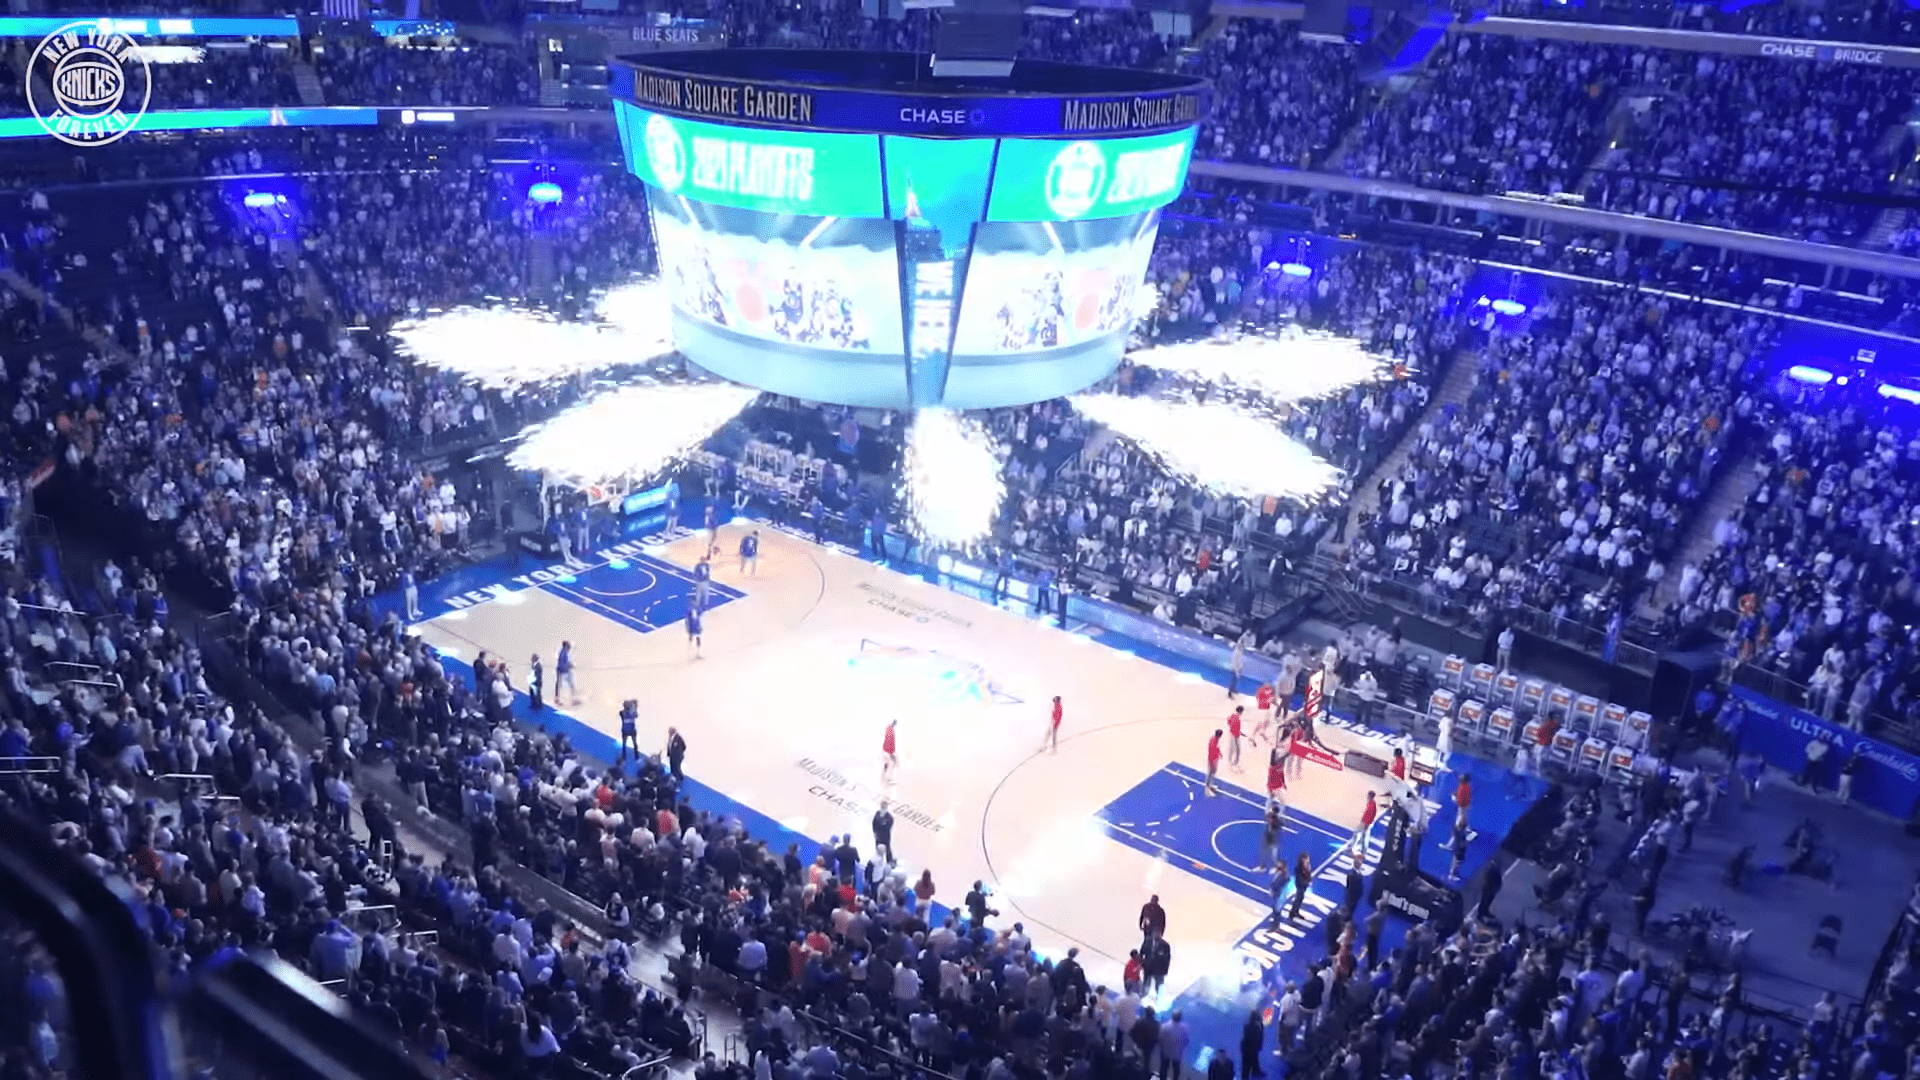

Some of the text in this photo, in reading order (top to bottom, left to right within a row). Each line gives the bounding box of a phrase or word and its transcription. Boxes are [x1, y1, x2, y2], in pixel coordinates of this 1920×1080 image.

[632, 26, 699, 43] BLUE SEATS
[1761, 43, 1885, 64] CHASE BRIDGE
[634, 69, 811, 122] MADISON SQUARE GARDEN
[900, 108, 966, 124] CHASE
[1064, 100, 1129, 130] MADISON
[1133, 97, 1172, 128] SQUARE
[444, 583, 512, 609] NEW
[512, 564, 594, 587] YORK
[1790, 717, 1844, 747] ULTRA
[798, 757, 944, 832] MADISON GARDEN
